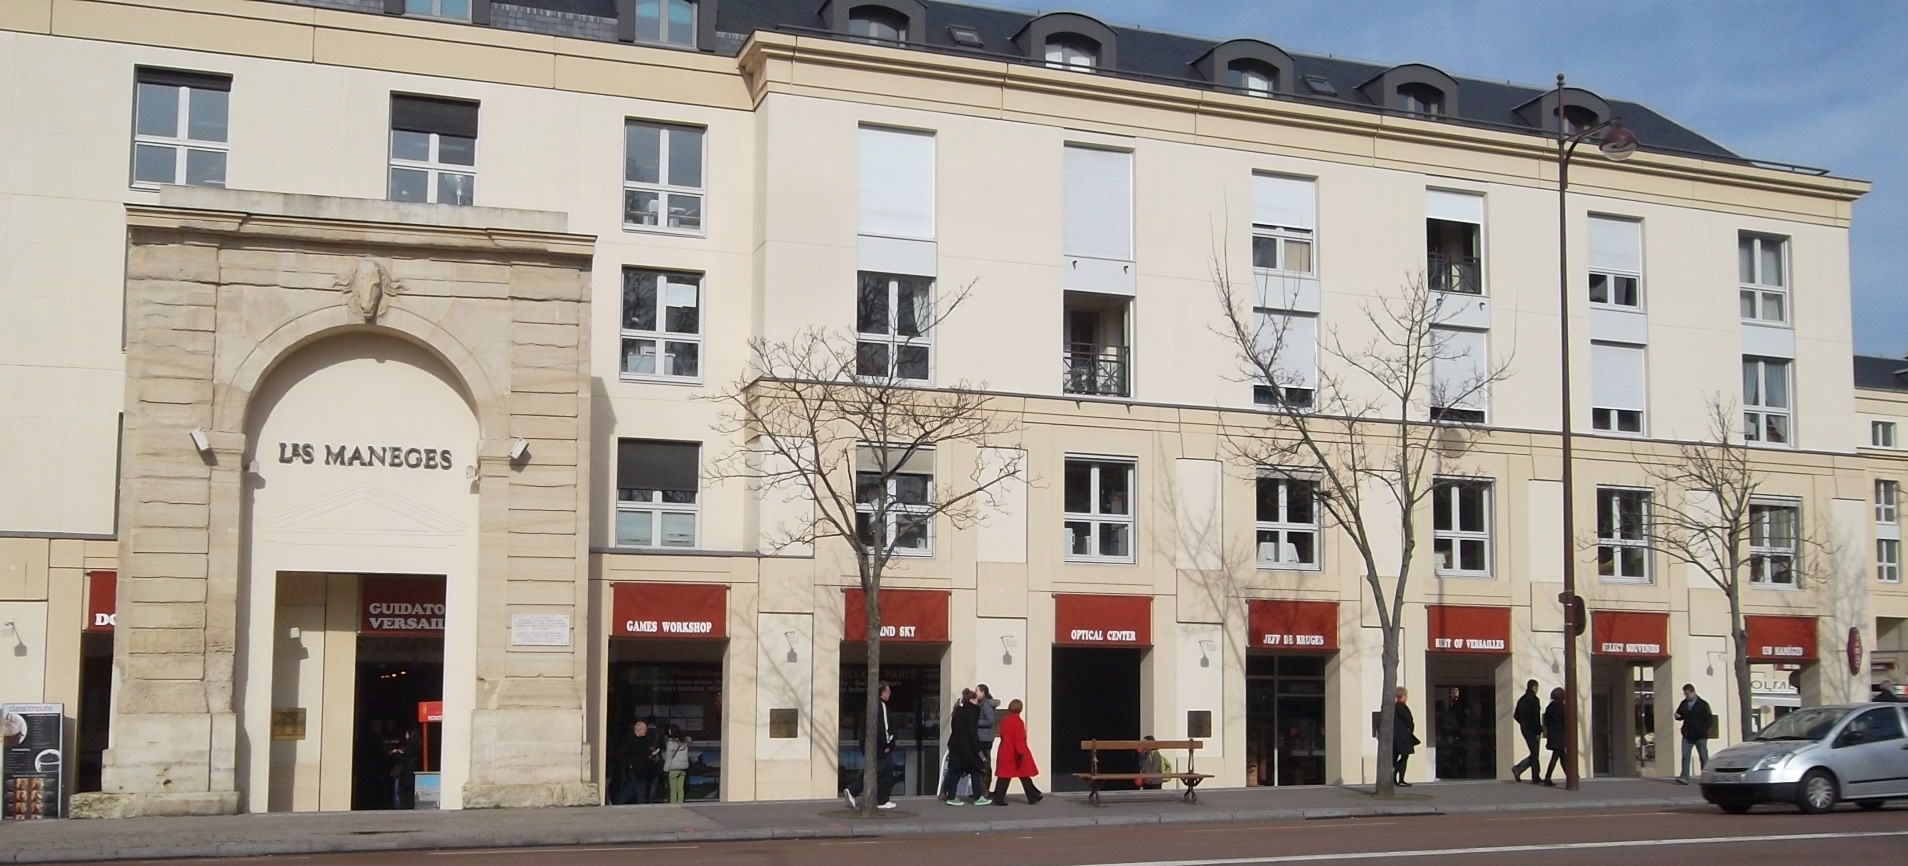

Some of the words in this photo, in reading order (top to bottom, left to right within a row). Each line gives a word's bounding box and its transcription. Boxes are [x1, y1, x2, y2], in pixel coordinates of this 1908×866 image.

[324, 444, 453, 471] MANEGES
[626, 620, 658, 633] GAMES
[661, 621, 712, 633] WORKSHOP
[899, 626, 916, 638] SKY
[1070, 629, 1104, 641] OPTICAL
[1106, 630, 1137, 641] CENTER
[1263, 633, 1281, 645] JEFF
[1283, 634, 1294, 645] DE
[1454, 638, 1464, 649] OF
[1466, 639, 1505, 650] VERSAILLES
